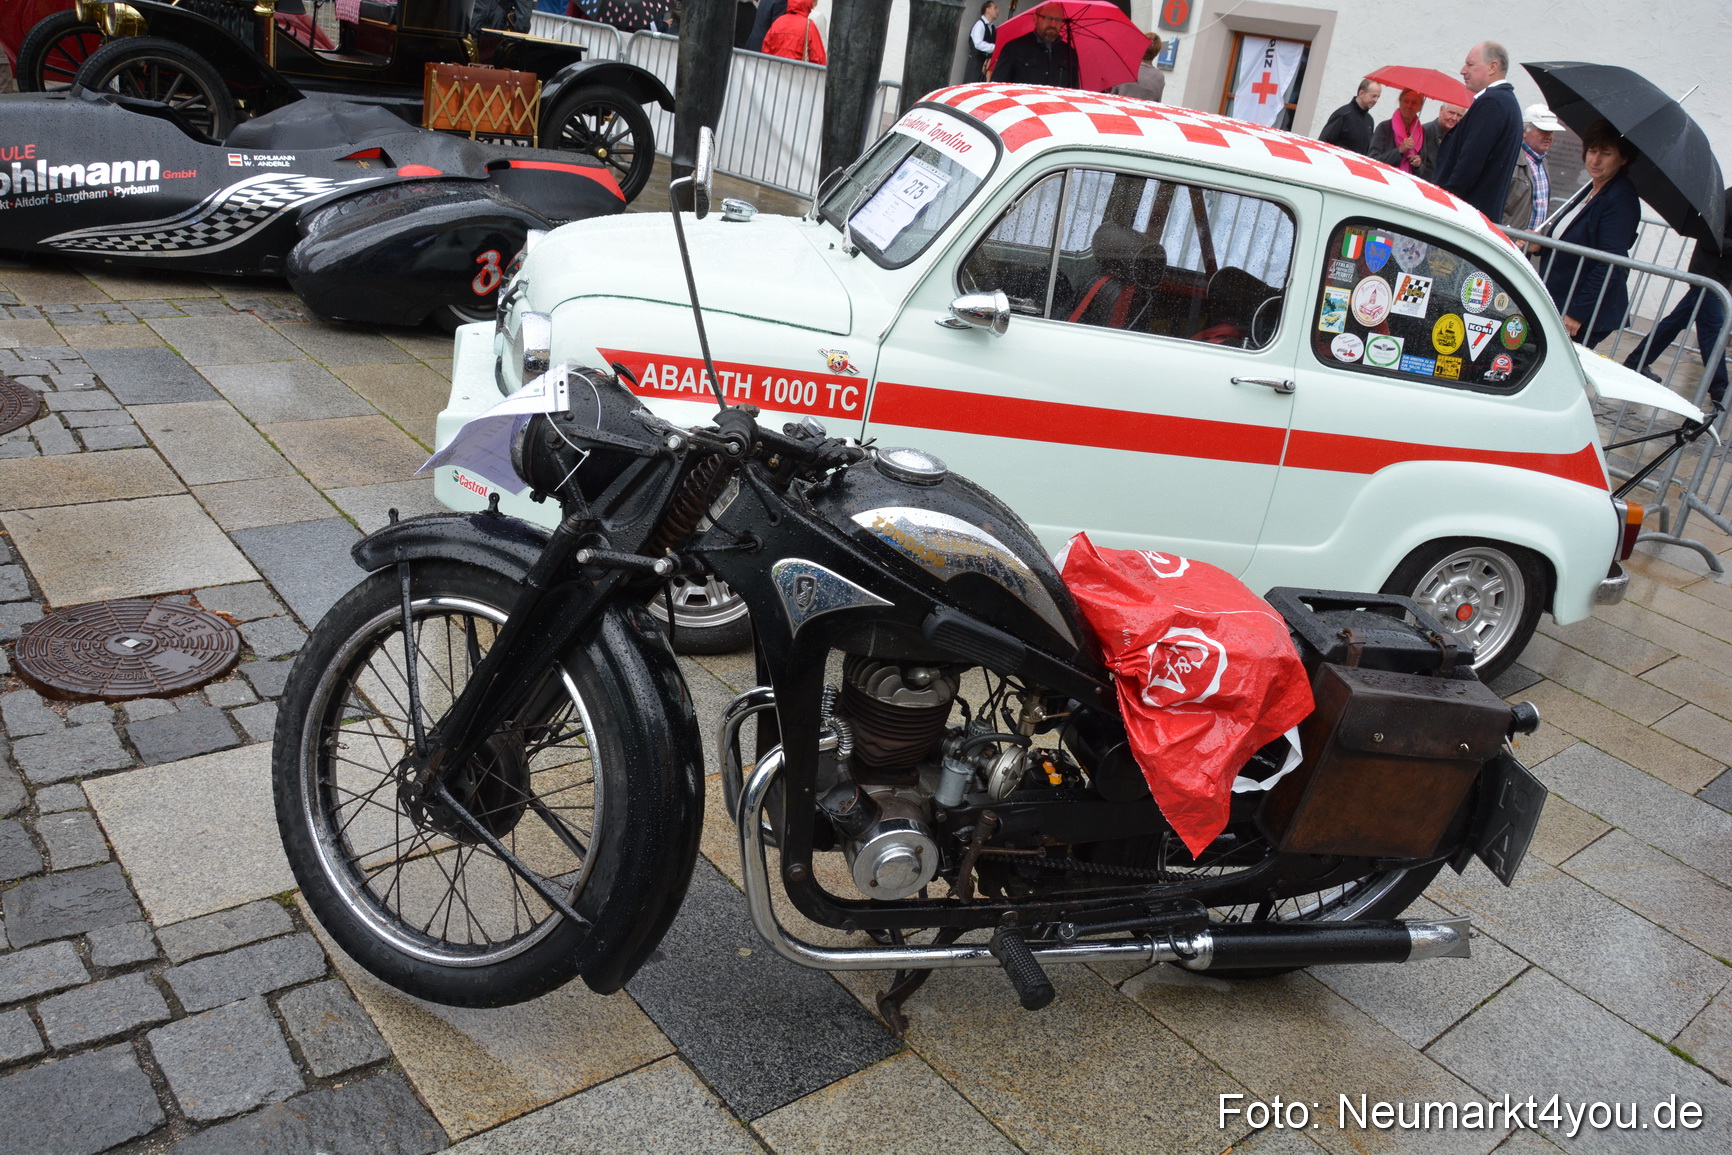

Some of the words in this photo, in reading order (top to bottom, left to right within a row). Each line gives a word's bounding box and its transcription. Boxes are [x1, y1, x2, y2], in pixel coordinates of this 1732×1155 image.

[927, 122, 973, 154] Topolino
[162, 169, 197, 180] GmbH
[15, 194, 50, 209] Altdorf
[55, 188, 108, 205] Burgthann
[113, 184, 160, 199] Pyrbaum
[902, 179, 929, 200] 275
[1469, 323, 1493, 335] KONI
[639, 362, 753, 400] ABARTH
[761, 376, 818, 408] 1000
[825, 383, 859, 412] TC
[459, 474, 489, 498] Castrol
